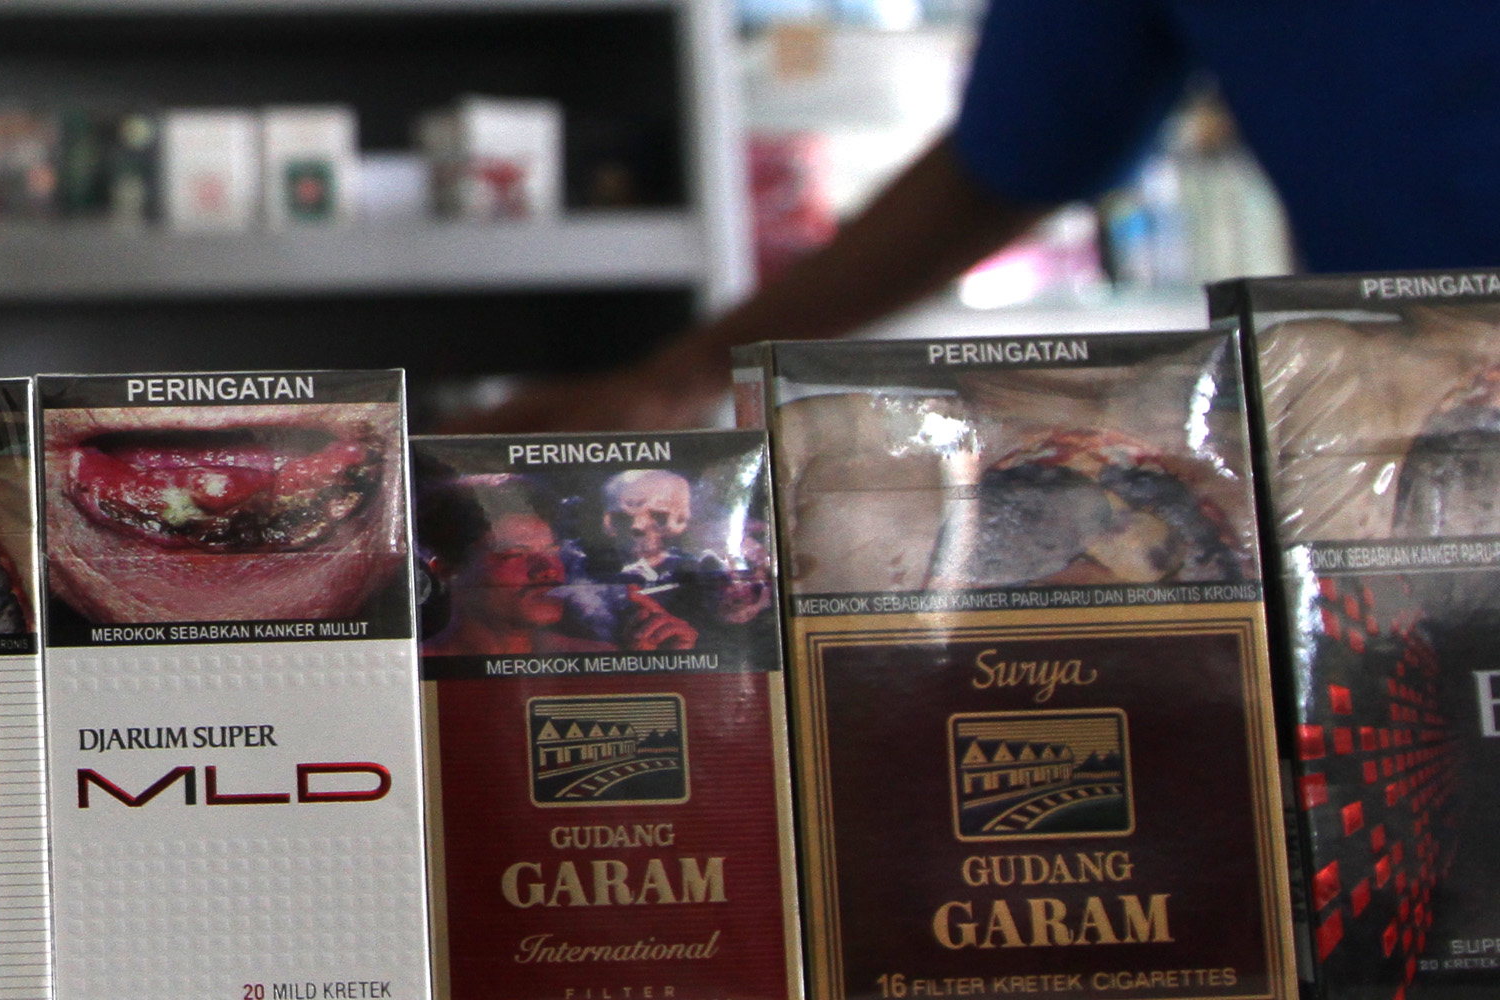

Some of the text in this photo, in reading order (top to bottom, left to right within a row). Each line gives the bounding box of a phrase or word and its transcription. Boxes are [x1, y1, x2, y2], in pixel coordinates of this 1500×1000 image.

[928, 342, 1089, 365] PERINGATAN
[127, 377, 314, 401] PERINGATAN
[508, 441, 671, 465] PERINGATAN
[1284, 549, 1344, 569] MOKOK
[799, 584, 1256, 614] MEROKOK SEBABKAN KANKER PARU-PARU DAN BRONKITIS KRONIS
[91, 622, 369, 641] MEROKOK SEBABKAN KANKER MULUT
[486, 654, 719, 675] MEROKOK MEMBUNUHMU
[972, 649, 1098, 702] Surya
[78, 724, 277, 752] DJARUM SUPER
[550, 823, 675, 849] GUDANG
[962, 851, 1135, 887] GUDANG
[501, 857, 728, 908] GARAM
[932, 893, 1175, 950] GARAM
[514, 929, 721, 963] International
[243, 981, 392, 1000] 20 MILD KRETEK
[565, 986, 675, 1000] FILTER
[877, 968, 1237, 998] 16 FILTER KRETEK CIGARETTES
